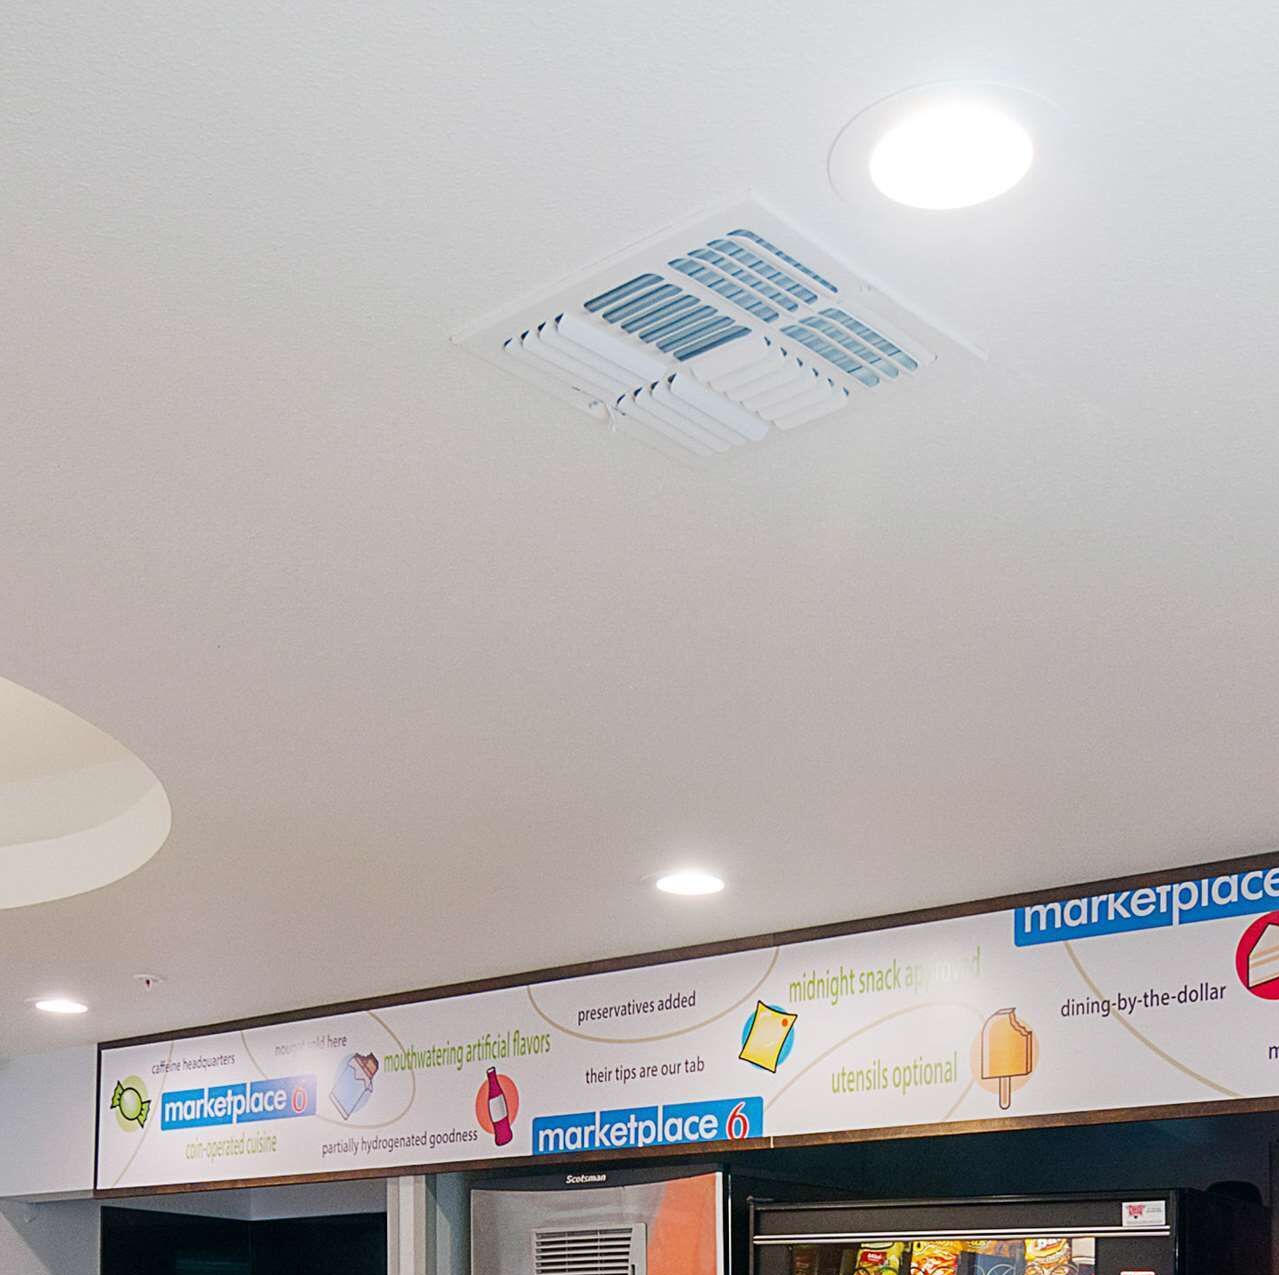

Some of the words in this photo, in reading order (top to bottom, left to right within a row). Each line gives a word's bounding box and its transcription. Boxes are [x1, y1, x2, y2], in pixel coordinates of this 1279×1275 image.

[789, 965, 856, 1006] midnight
[858, 958, 902, 994] snack
[578, 999, 655, 1025] preservatives
[657, 990, 696, 1012] added
[1060, 982, 1227, 1019] dining-by-the-dollar
[327, 1033, 348, 1048] here
[384, 1041, 463, 1073] mouthwatering
[466, 1032, 509, 1061] artificial
[512, 1029, 551, 1056] flavors
[151, 1060, 181, 1075] caffeine
[182, 1053, 236, 1073] headquarters
[585, 1065, 612, 1084] their
[615, 1064, 637, 1084] tips
[639, 1064, 658, 1079] are
[660, 1061, 682, 1076] our
[684, 1056, 705, 1072] tab
[832, 1059, 888, 1094] utensils
[893, 1051, 958, 1095] optional
[164, 1082, 287, 1123] marketplace
[321, 1136, 359, 1157] partially
[361, 1131, 427, 1154] hydrogenated
[429, 1129, 478, 1148] goodness
[538, 1104, 718, 1152] marketplace
[725, 1101, 750, 1140] 6
[185, 1134, 245, 1161] coin-operated
[247, 1133, 277, 1153] cuisine
[565, 1174, 607, 1185] Scotsman
